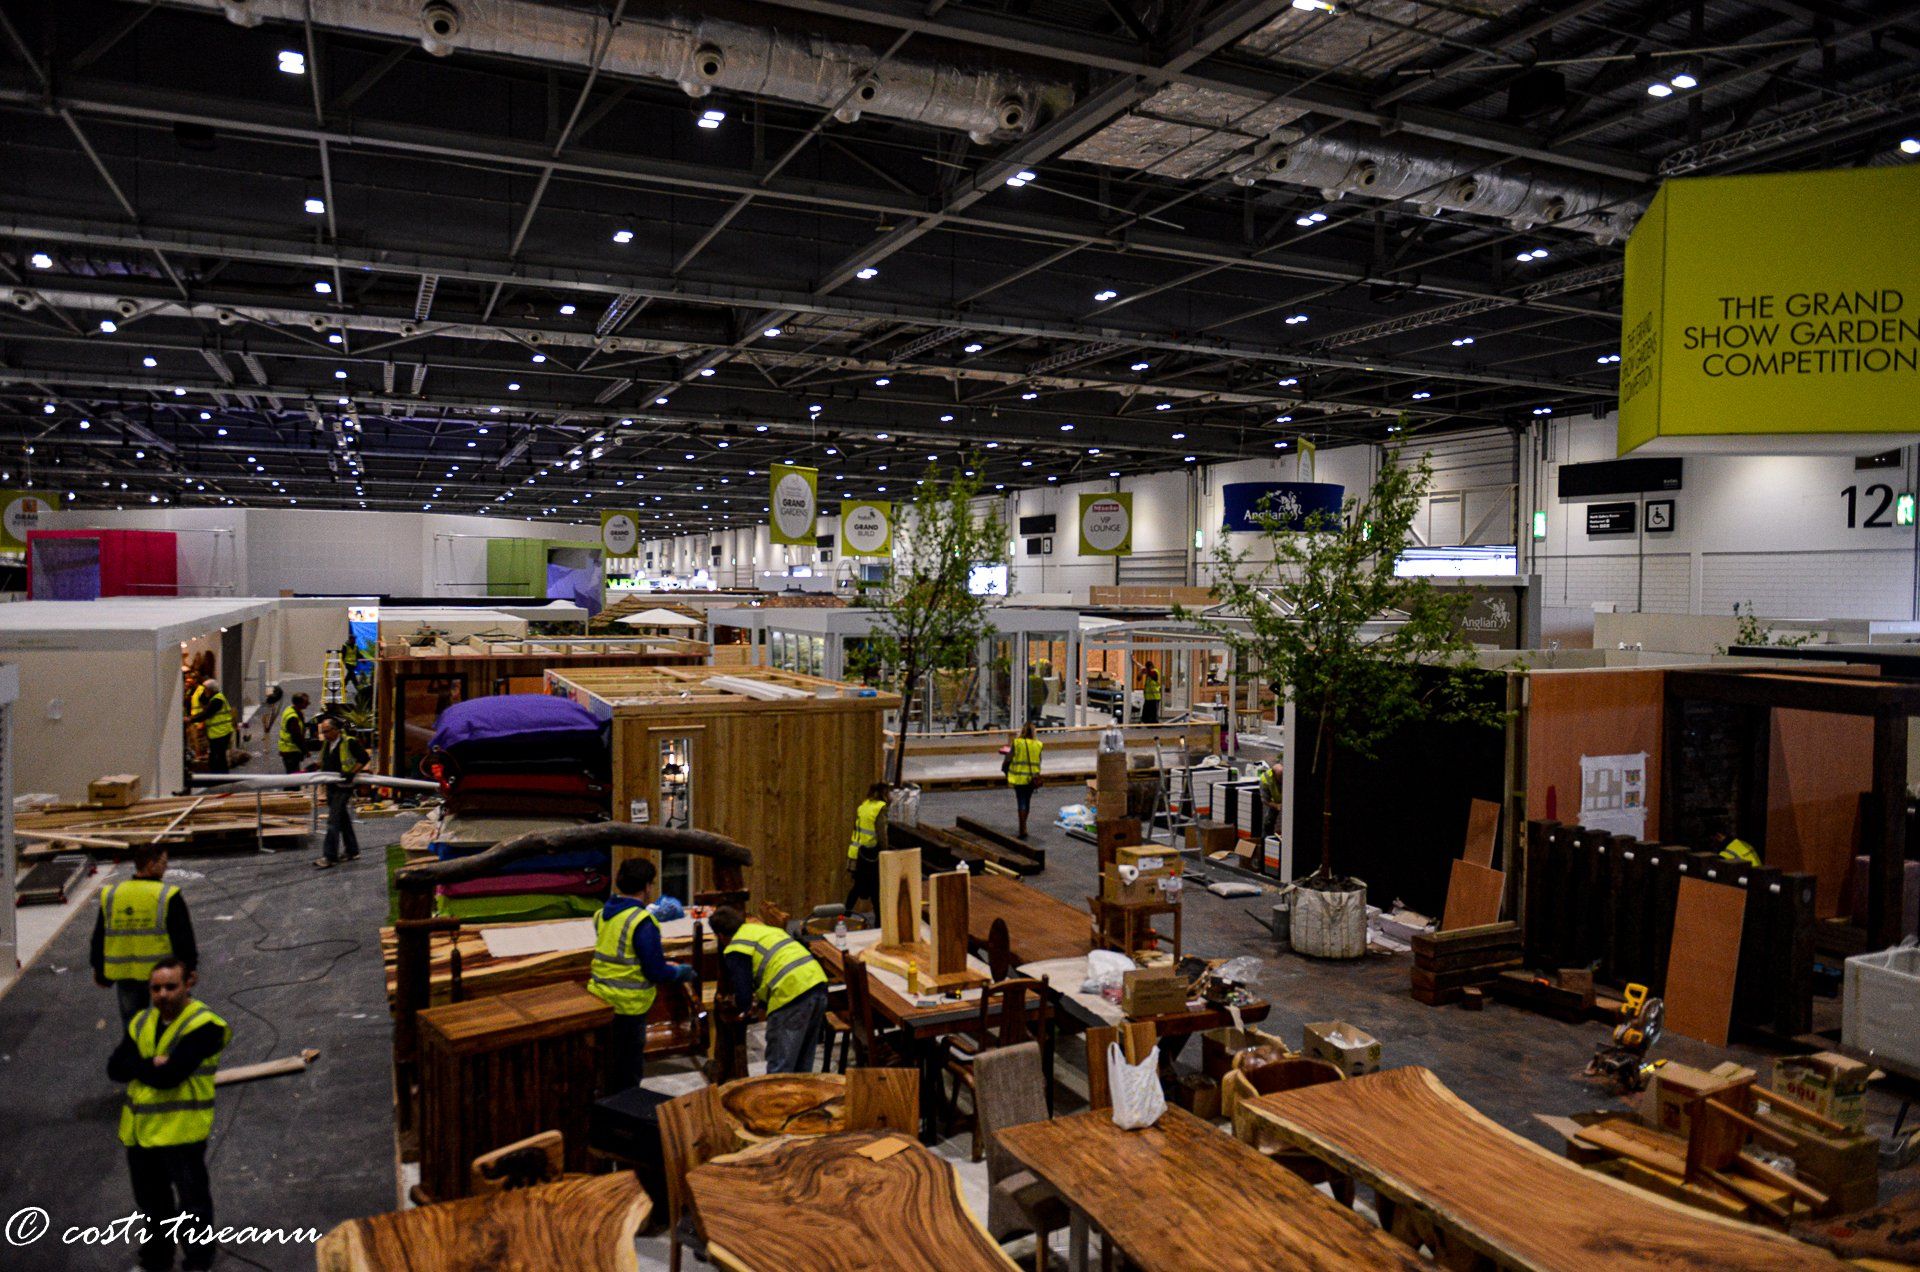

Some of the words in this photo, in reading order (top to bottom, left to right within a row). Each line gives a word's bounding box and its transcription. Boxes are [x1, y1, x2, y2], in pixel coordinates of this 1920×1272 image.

[1718, 295, 1774, 320] THE
[1785, 289, 1904, 318] GRAND
[1683, 324, 1780, 350] SHOW
[1702, 347, 1918, 378] COMPETITION
[782, 498, 807, 509] GRAND
[1840, 483, 1894, 529] 12
[780, 508, 809, 518] GARDENS
[853, 523, 879, 531] GRAND
[1090, 524, 1121, 533] LOUNGE
[1461, 615, 1498, 631] Anglian
